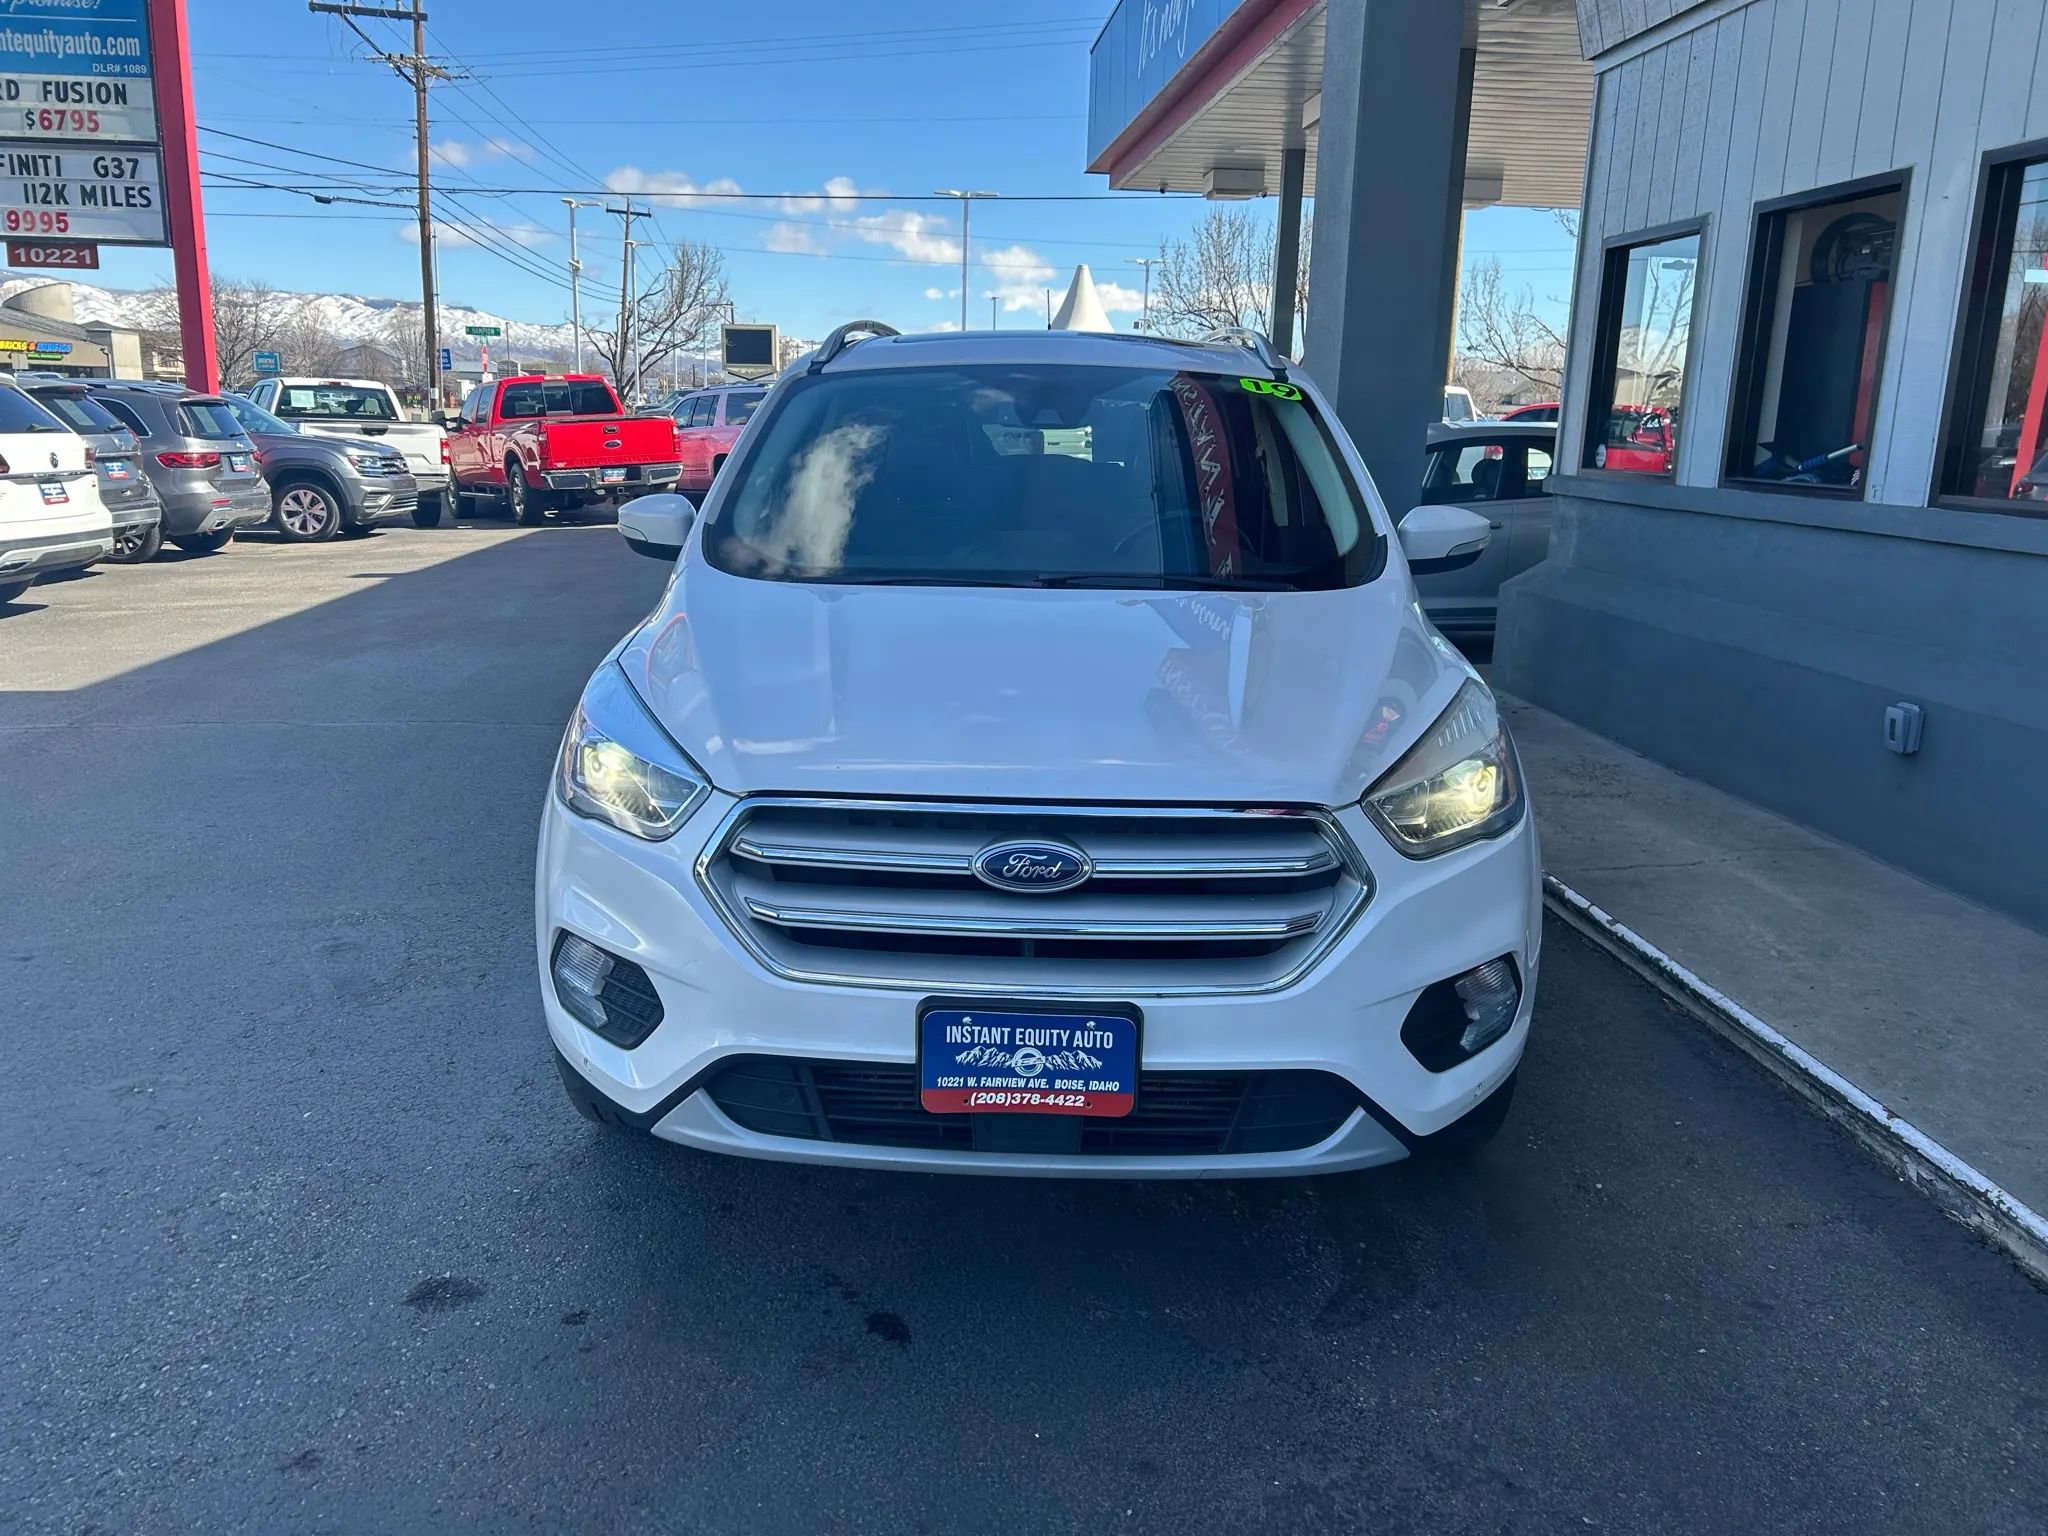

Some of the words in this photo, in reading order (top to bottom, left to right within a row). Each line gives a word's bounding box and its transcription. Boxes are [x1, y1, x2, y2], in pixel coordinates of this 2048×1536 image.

[92, 63, 120, 73] DLR#
[123, 64, 147, 74] 1089
[0, 78, 20, 101] D
[42, 80, 128, 105] FUSION
[24, 107, 100, 133] $6795
[93, 155, 139, 179] G37
[23, 183, 69, 205] 112K
[80, 184, 152, 208] MILES
[6, 209, 69, 233] 9995
[14, 247, 91, 264] 10221
[1247, 379, 1297, 398] 19
[1003, 853, 1062, 878] Ford
[946, 1025, 1011, 1045] INSTANT
[1015, 1028, 1070, 1047] EQUITY
[1072, 1030, 1113, 1049] AUTO
[937, 1076, 964, 1087] 10221
[967, 1077, 978, 1088] W.
[980, 1077, 1028, 1088] FAIRVIEW
[1027, 1078, 1049, 1089] AVE.
[1054, 1079, 1086, 1092] BOISE,
[1088, 1080, 1120, 1092] IDAHO
[970, 1091, 1085, 1107] (208)378-4422
